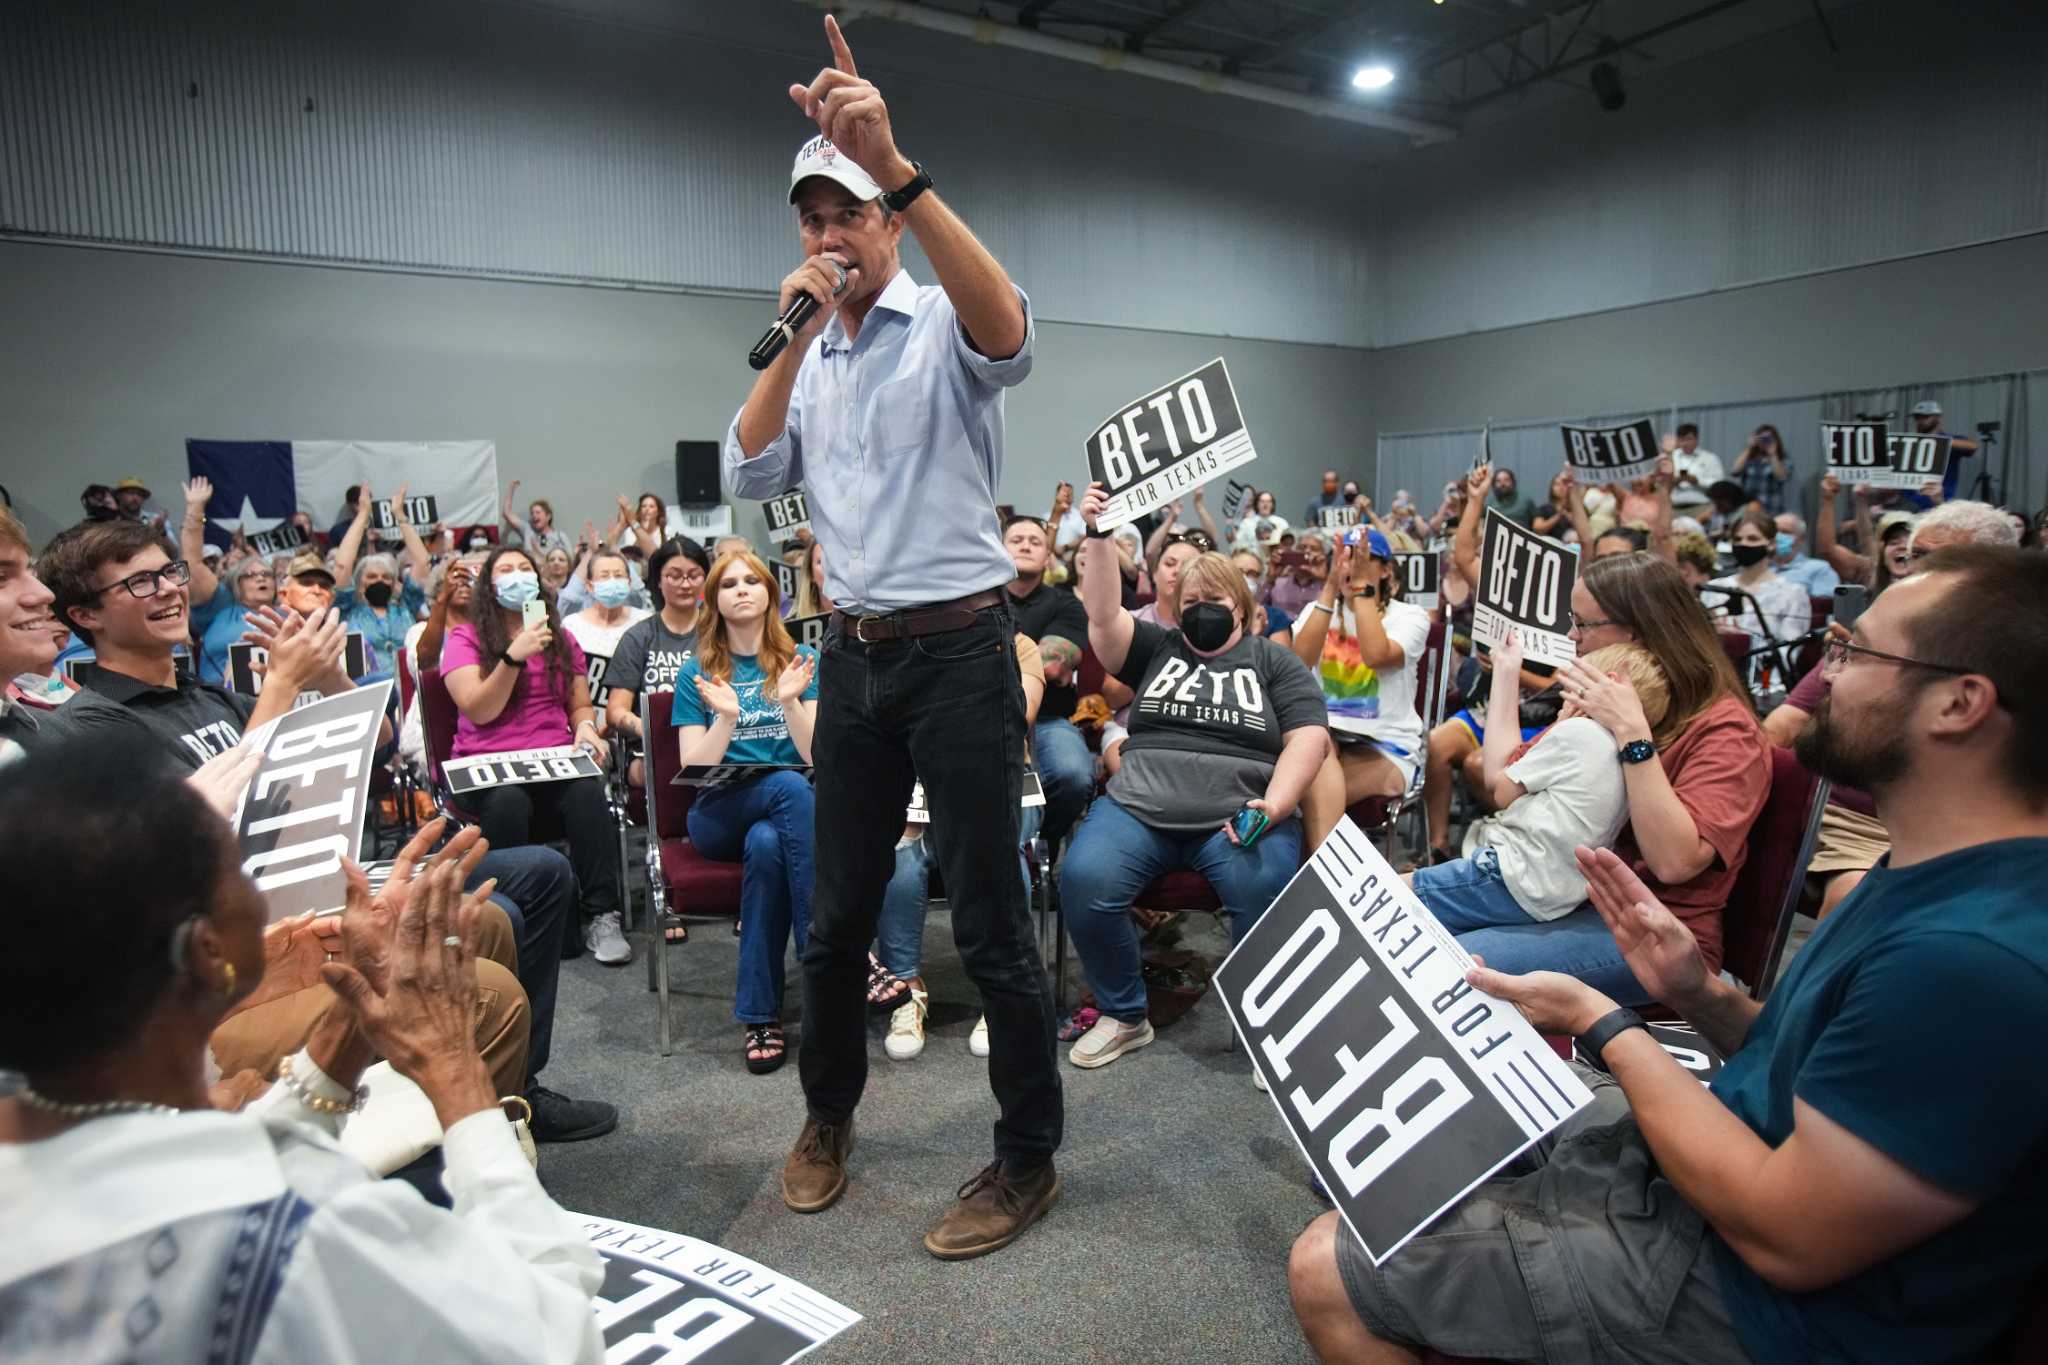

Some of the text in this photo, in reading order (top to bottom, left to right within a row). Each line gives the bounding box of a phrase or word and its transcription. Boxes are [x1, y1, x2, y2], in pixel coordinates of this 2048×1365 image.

[802, 138, 832, 161] TEXAS
[1099, 378, 1217, 490] BETO
[1569, 427, 1645, 467] BETO
[1822, 425, 1875, 465] ETO
[1126, 450, 1217, 511] FOR TEXAS
[380, 498, 430, 528] BTO
[770, 495, 807, 528] BET
[1489, 523, 1561, 626] BETO
[1490, 615, 1505, 642] FOR
[645, 667, 680, 684] OFF
[1143, 656, 1263, 713] BETO
[1162, 702, 1239, 725] FOR TEXAS
[468, 758, 580, 786] BETO
[240, 710, 374, 892] BETO
[1348, 874, 1438, 979] TEXAS
[1432, 977, 1513, 1060] FOR
[1241, 909, 1474, 1198] BETO
[693, 1258, 776, 1299] FOR
